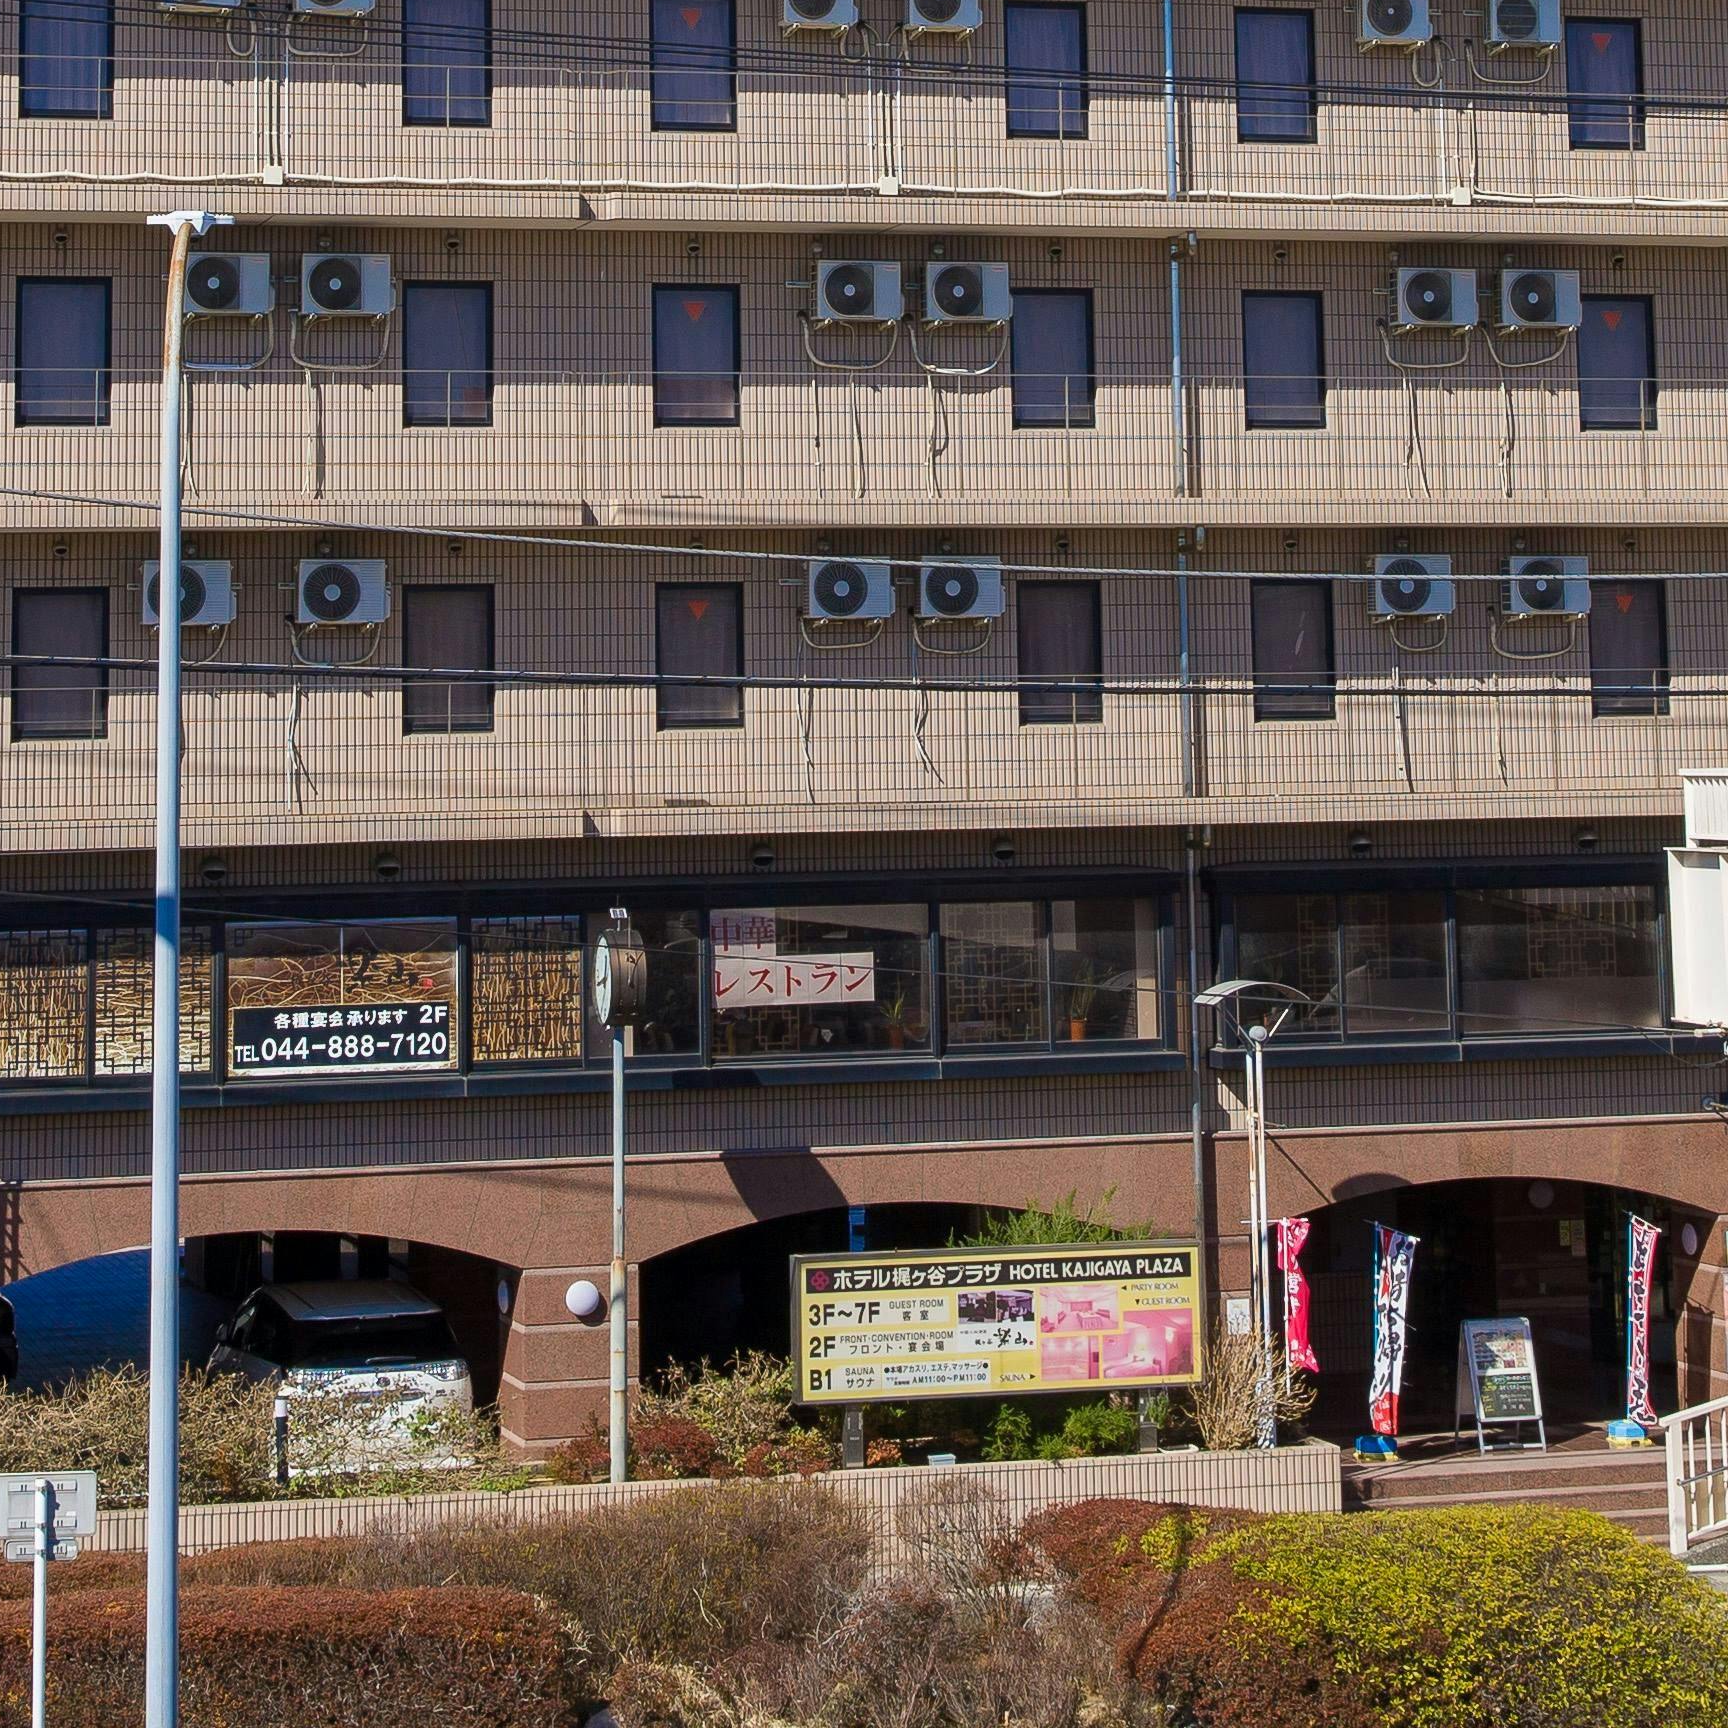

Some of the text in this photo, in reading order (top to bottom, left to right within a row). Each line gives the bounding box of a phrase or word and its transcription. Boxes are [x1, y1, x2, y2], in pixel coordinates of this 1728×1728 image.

[711, 916, 773, 951] 中華
[714, 963, 872, 998] レストラン
[274, 1005, 448, 1029] 各種宴会承ります 2F
[235, 1032, 448, 1063] TEL 044-888-7120
[833, 1257, 1184, 1290] ホテル梶ヶ谷プラザ HOTEL KAJIGAYA PLAZA
[1130, 1282, 1179, 1291] PARTY ROOM
[889, 1298, 944, 1310] GUEST ROOM
[1165, 1296, 1191, 1304] ROOM
[809, 1335, 836, 1358] 2F
[810, 1368, 832, 1390] B1
[845, 1367, 875, 1376] SAUNA
[846, 1377, 875, 1388] サウナ
[999, 1374, 1026, 1383] SAUNA
